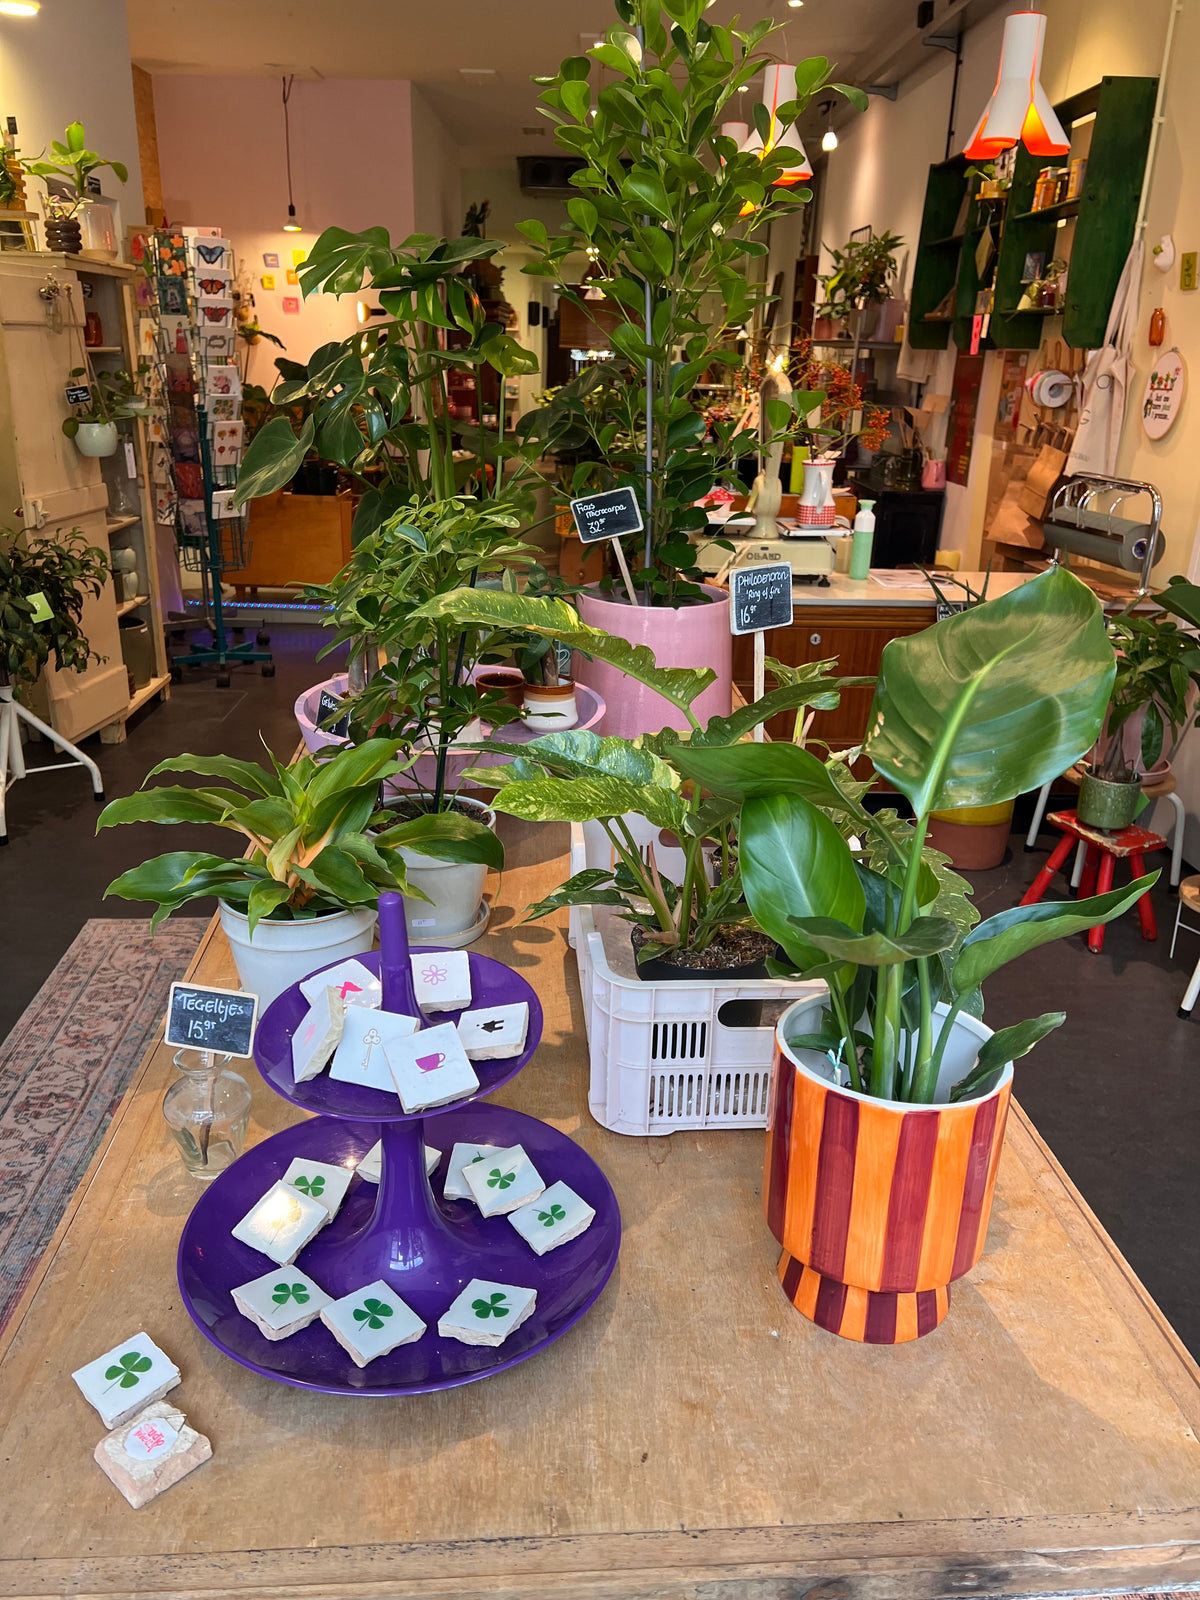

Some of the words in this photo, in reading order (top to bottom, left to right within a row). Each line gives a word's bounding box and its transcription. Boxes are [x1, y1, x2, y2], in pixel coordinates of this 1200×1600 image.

[576, 503, 595, 514] Ficus
[586, 504, 626, 518] microcarpa
[762, 587, 768, 599] of
